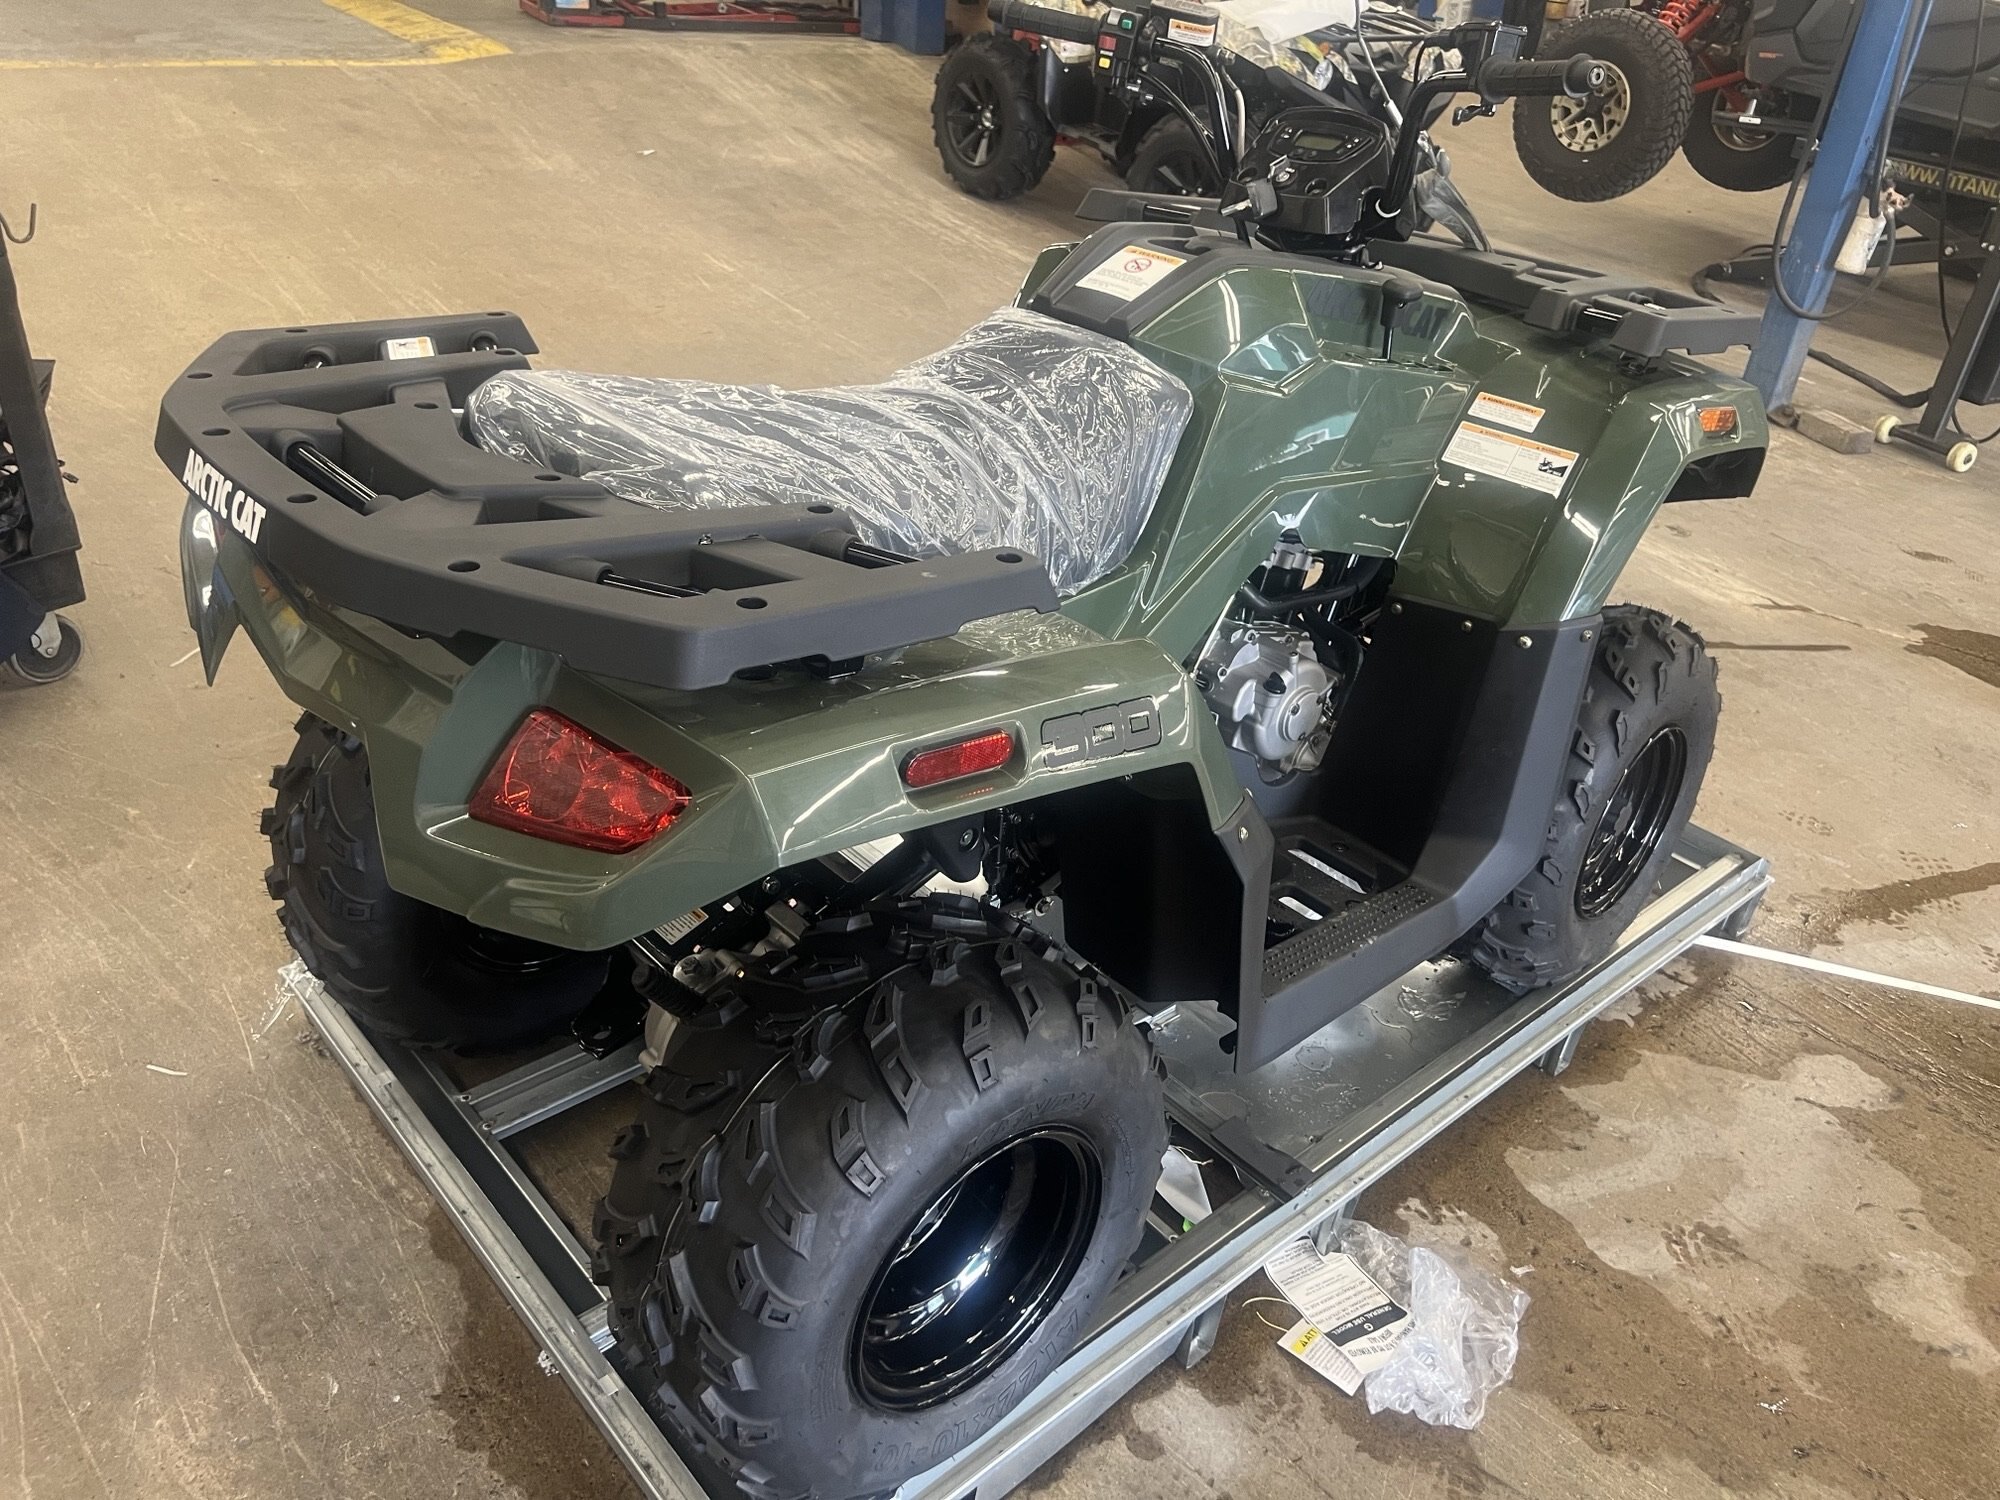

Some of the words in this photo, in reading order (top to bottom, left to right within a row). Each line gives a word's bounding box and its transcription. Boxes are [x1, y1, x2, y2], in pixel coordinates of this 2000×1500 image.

[183, 448, 233, 520] ARCTIC
[231, 489, 267, 544] CAT
[1363, 1303, 1392, 1320] GENERAL
[1351, 1315, 1366, 1326] USE
[1362, 1320, 1374, 1333] G
[1330, 1321, 1354, 1337] MODEL
